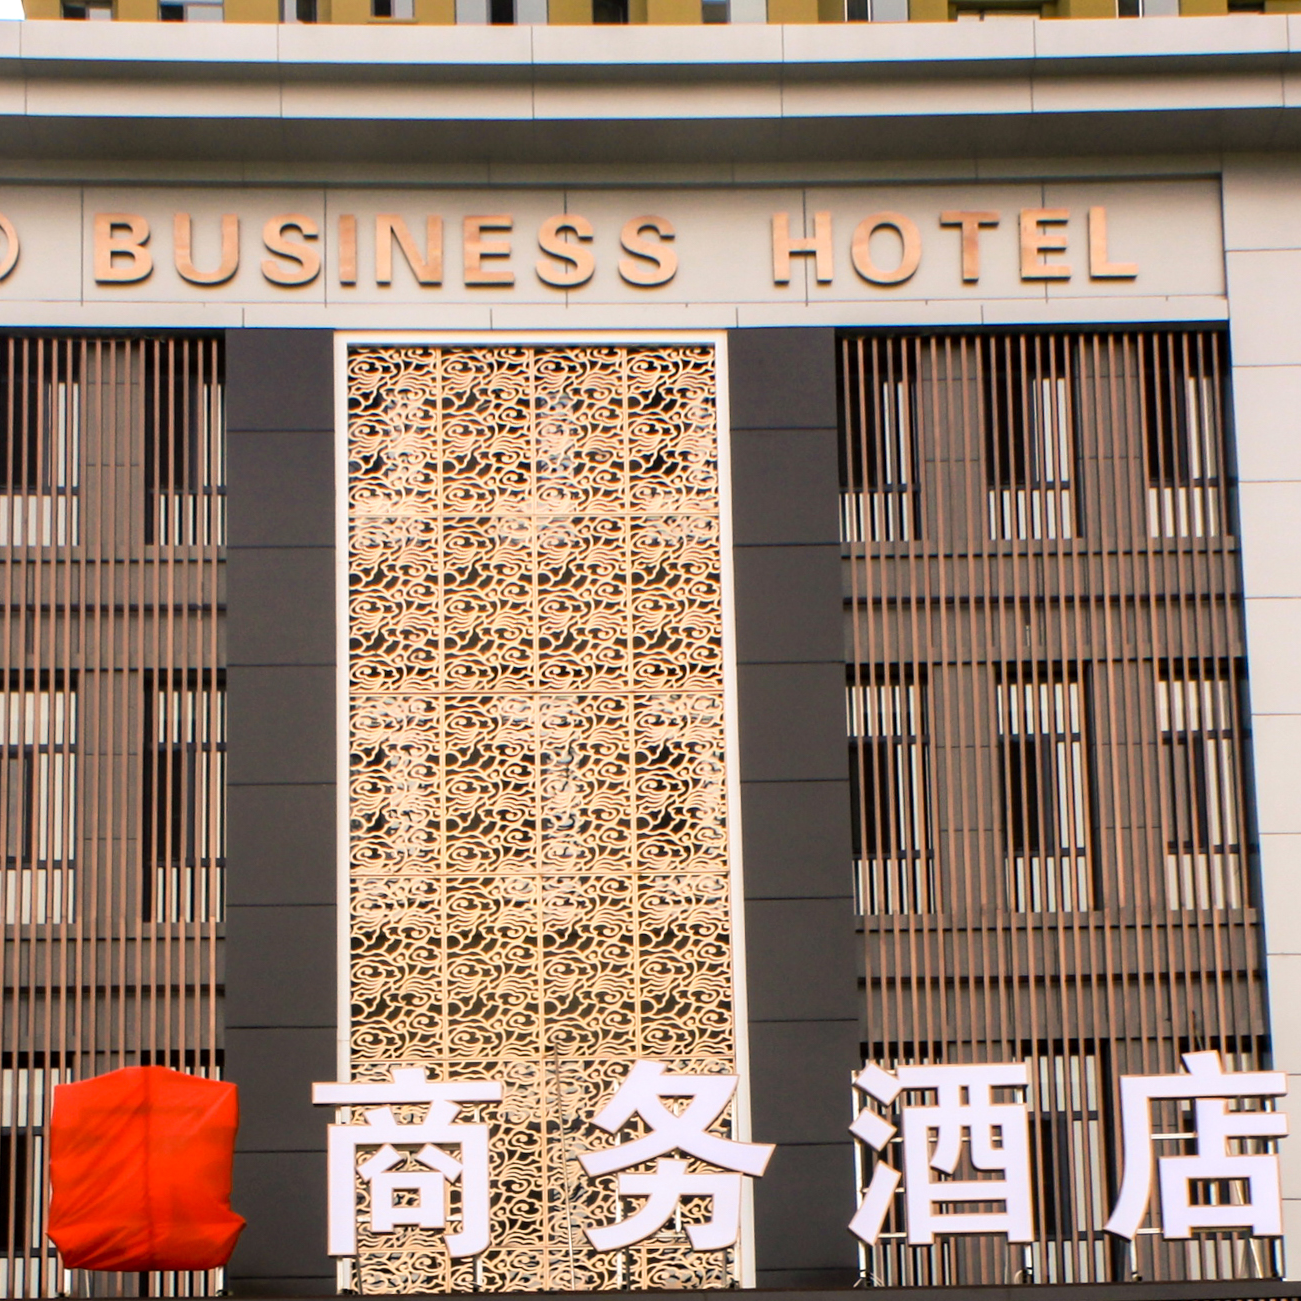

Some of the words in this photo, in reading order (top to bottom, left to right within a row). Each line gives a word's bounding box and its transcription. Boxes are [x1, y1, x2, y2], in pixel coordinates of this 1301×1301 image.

[93, 211, 680, 287] BUSINESS
[770, 208, 1139, 286] HOTEL
[311, 1052, 1290, 1257] 商务酒店
